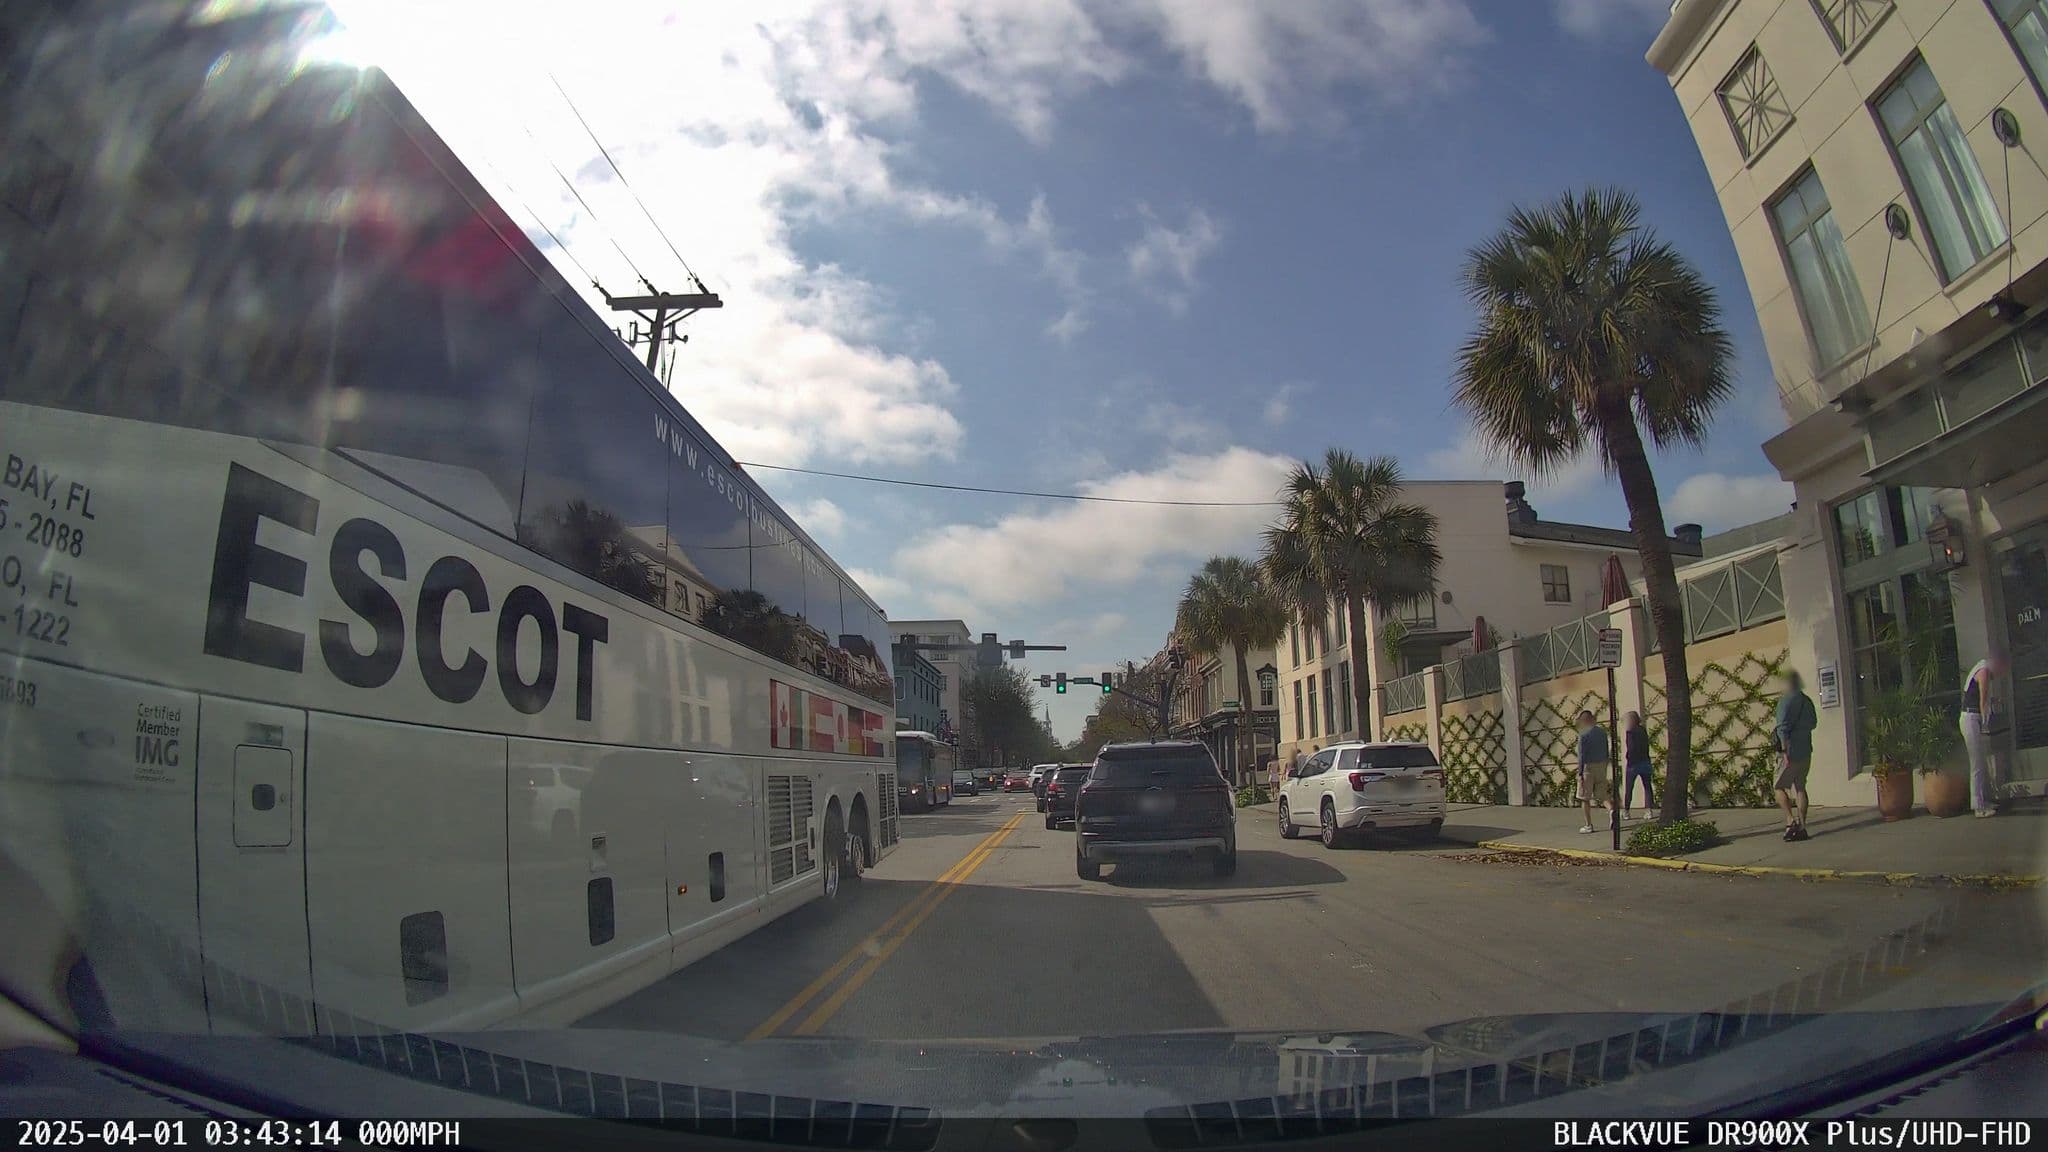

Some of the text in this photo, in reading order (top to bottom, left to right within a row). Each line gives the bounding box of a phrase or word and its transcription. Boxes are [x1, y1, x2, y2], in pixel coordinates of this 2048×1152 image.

[3, 453, 95, 520] BAY, FL
[48, 570, 78, 608] FL
[203, 460, 609, 722] ESCOT
[136, 718, 180, 737] Member
[137, 703, 181, 722] Certified
[135, 735, 179, 767] IMG
